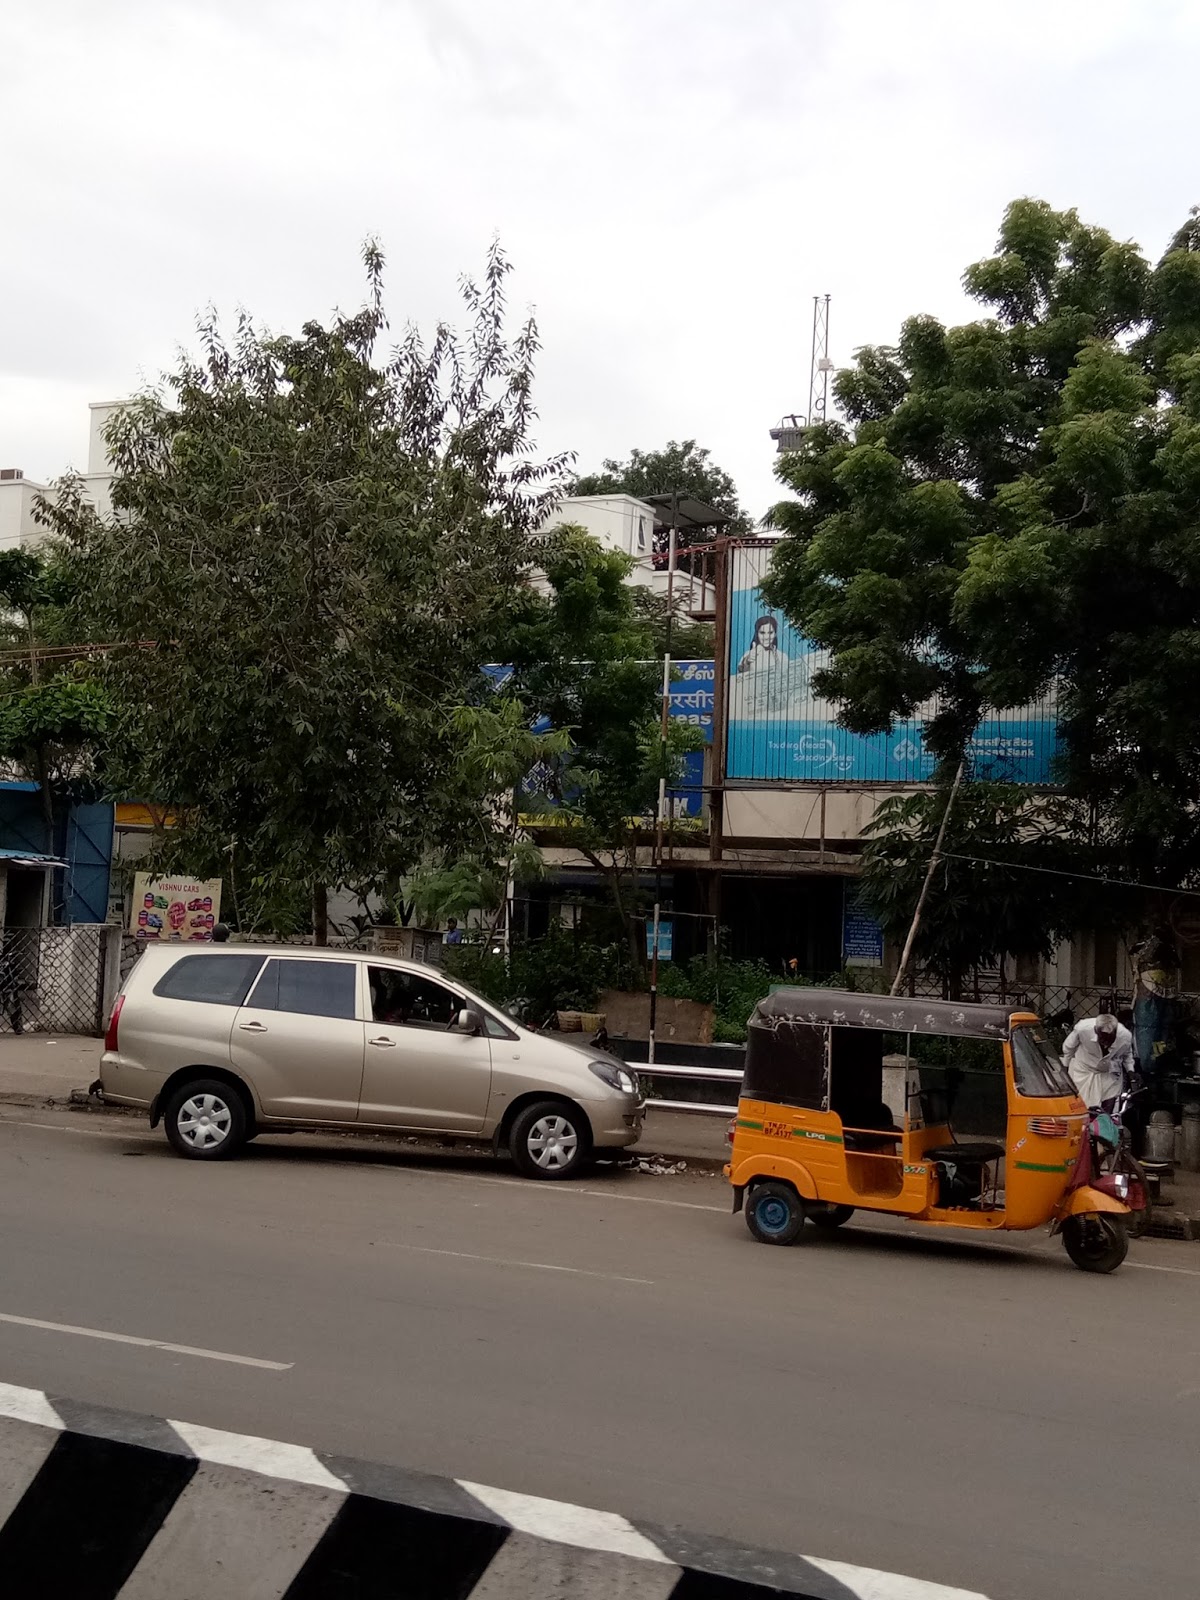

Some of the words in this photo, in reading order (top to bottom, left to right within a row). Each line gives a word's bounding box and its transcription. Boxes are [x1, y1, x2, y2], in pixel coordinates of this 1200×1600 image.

[159, 883, 182, 892] VISHNU
[183, 885, 200, 893] CARS
[805, 1131, 826, 1140] LPG
